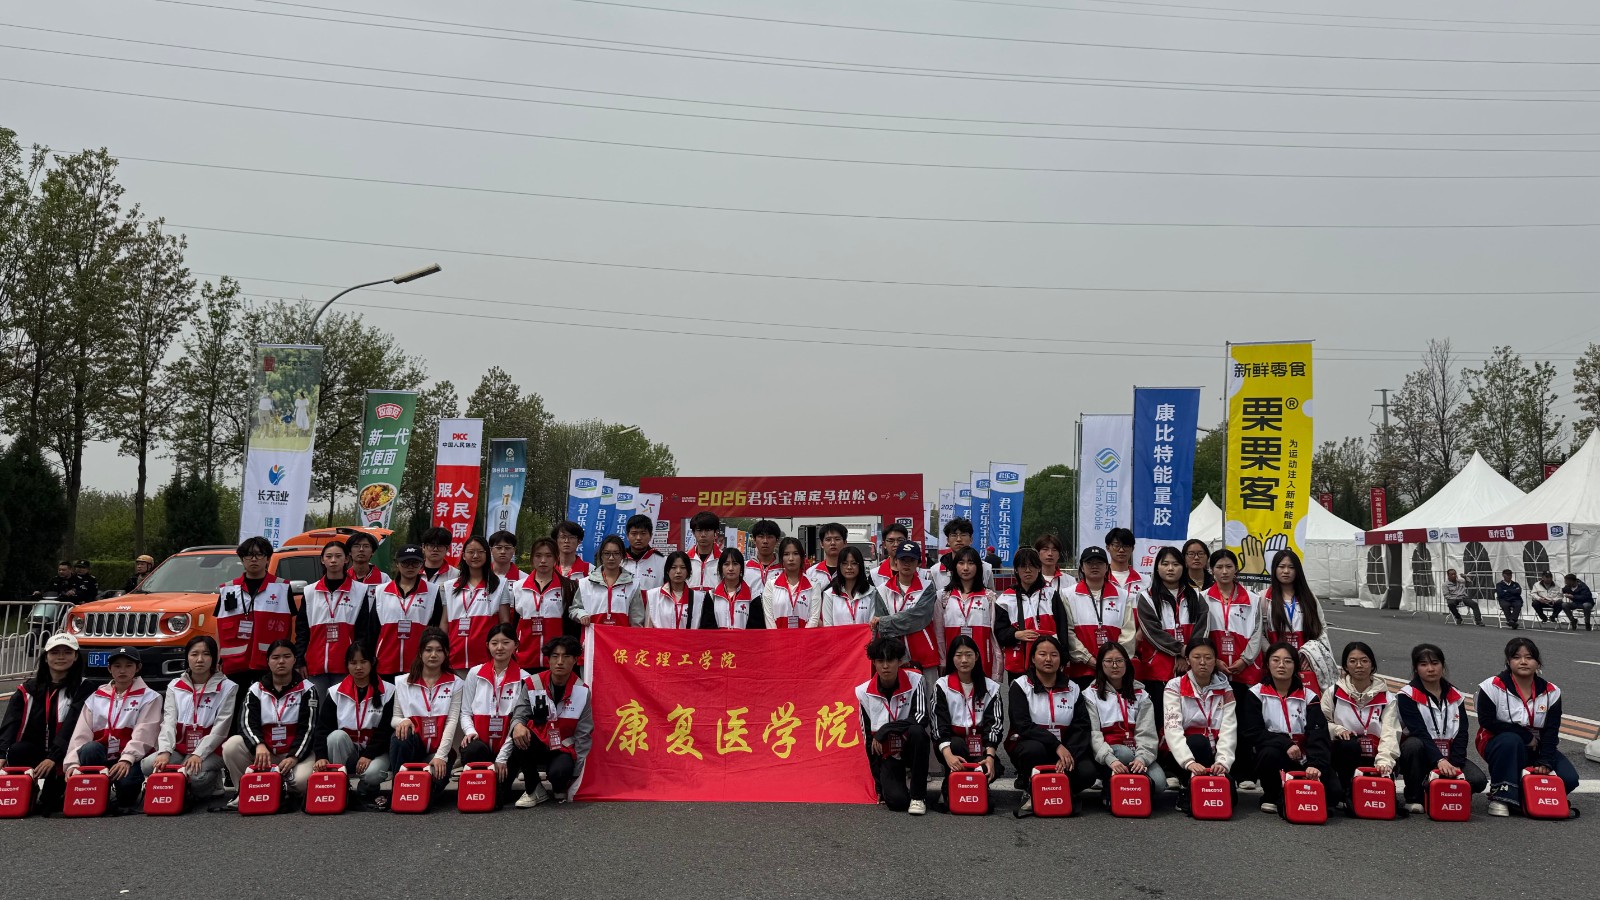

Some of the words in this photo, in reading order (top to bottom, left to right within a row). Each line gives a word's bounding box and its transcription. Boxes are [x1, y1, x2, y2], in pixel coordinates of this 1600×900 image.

[1234, 362, 1306, 378] 新鲜零食
[368, 427, 410, 446] 新一代
[452, 433, 468, 441] PICC
[361, 448, 398, 467] 方便面
[1240, 397, 1282, 511] 栗栗客
[1152, 403, 1176, 527] 康比特能量胶
[1283, 439, 1298, 530] 为运动注入新鲜能量
[1095, 477, 1104, 502] China
[1105, 478, 1117, 530] 中国移动
[450, 482, 473, 558] 人民保险
[1094, 503, 1104, 531] Mobile
[997, 497, 1011, 562] 君乐宝集团
[613, 648, 737, 670] 保定理工学院
[605, 699, 860, 760] 康复医学院
[73, 797, 96, 806] AED
[152, 796, 173, 804] AED
[248, 794, 270, 803] AED
[315, 795, 336, 803] AED
[400, 794, 420, 802] AED
[466, 793, 486, 801] AED
[959, 795, 979, 803] AED
[1044, 797, 1064, 806] AED
[1122, 798, 1143, 806] AED
[1203, 799, 1224, 807] AED
[1365, 800, 1386, 809] AED
[1538, 798, 1560, 806] AED
[1298, 803, 1319, 812] AED
[1442, 803, 1463, 811] AED
